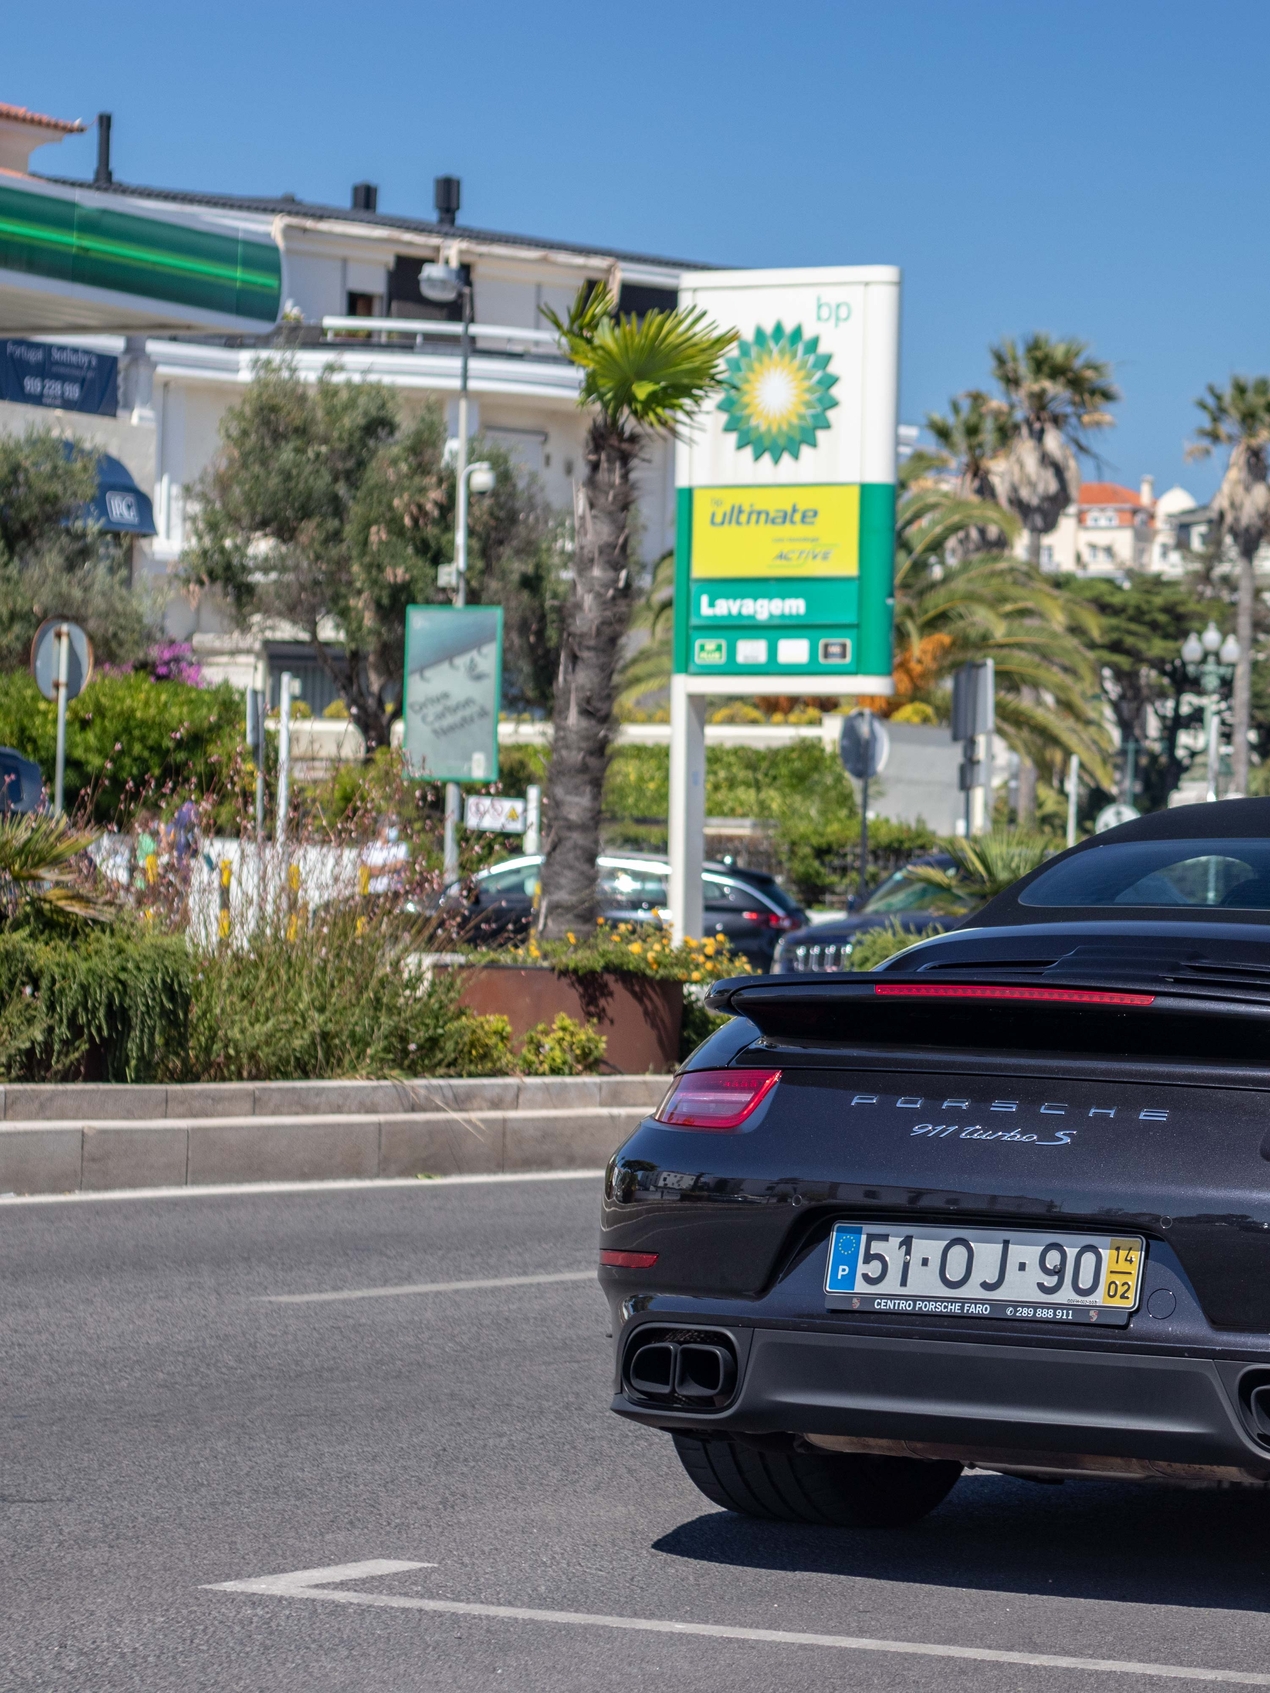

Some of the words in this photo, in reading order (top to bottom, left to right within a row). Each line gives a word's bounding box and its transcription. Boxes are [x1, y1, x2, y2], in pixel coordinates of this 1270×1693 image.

[816, 296, 851, 327] bp
[710, 503, 818, 527] ultimate
[773, 549, 834, 562] ACTIVE
[700, 594, 807, 621] Lavagem
[409, 690, 450, 715] Drive
[421, 696, 476, 728] Carbon
[851, 1095, 1170, 1121] PORSCHE
[910, 1123, 957, 1138] 911
[959, 1124, 1039, 1143] turbo
[1036, 1130, 1077, 1145] S
[1114, 1245, 1135, 1265] 14
[837, 1266, 849, 1280] P
[1107, 1280, 1131, 1300] 02
[874, 1299, 913, 1312] CENTRO
[915, 1300, 962, 1314] PORSCHE
[964, 1303, 991, 1315] FARO
[1016, 1306, 1034, 1318] 289
[1036, 1308, 1054, 1318] 888
[1056, 1309, 1073, 1320] 911
